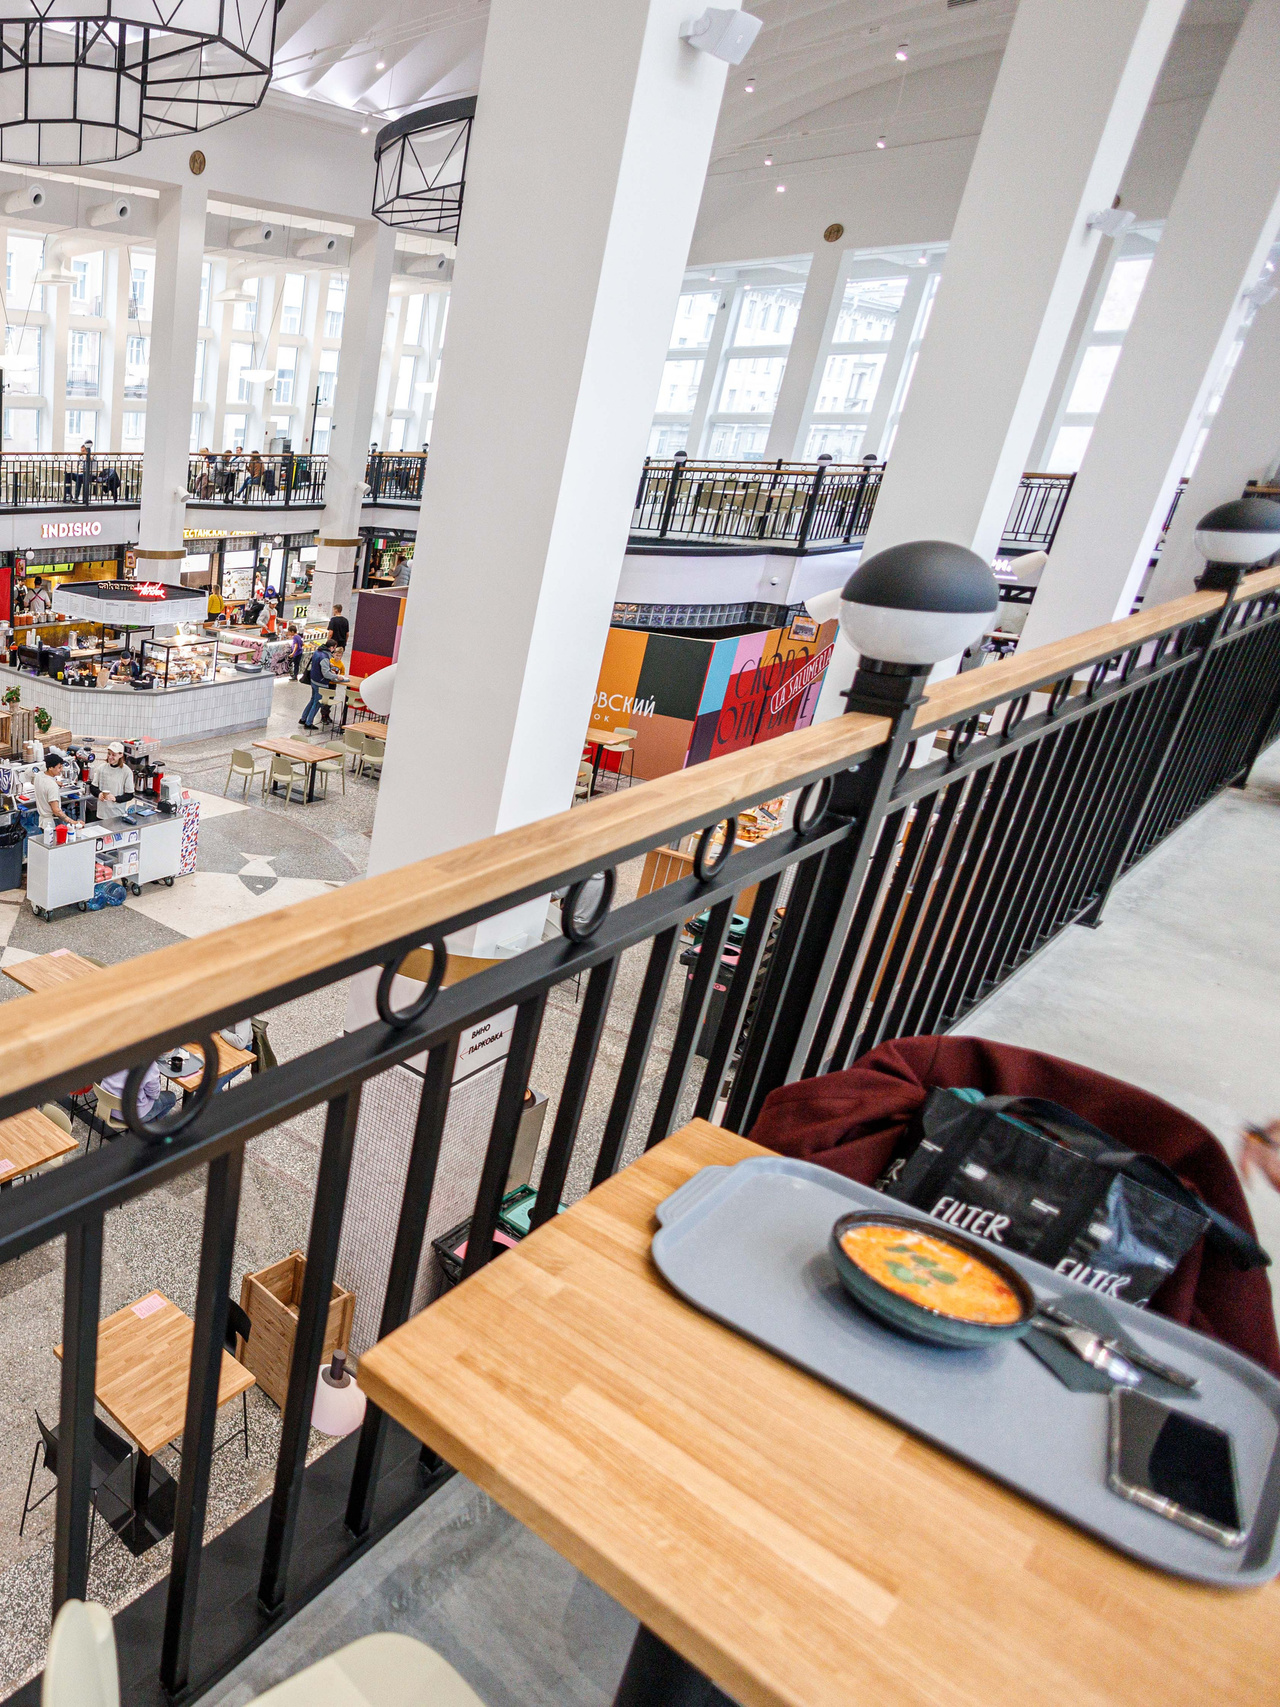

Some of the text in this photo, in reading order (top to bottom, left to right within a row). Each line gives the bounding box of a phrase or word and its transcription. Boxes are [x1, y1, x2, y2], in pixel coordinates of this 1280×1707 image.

[41, 521, 102, 539] INDISKO
[774, 647, 833, 710] LA SALUMERIA
[468, 1031, 503, 1055] ПАРКОВКА
[471, 1023, 491, 1040] ВИНО
[929, 1195, 1011, 1242] FILTER
